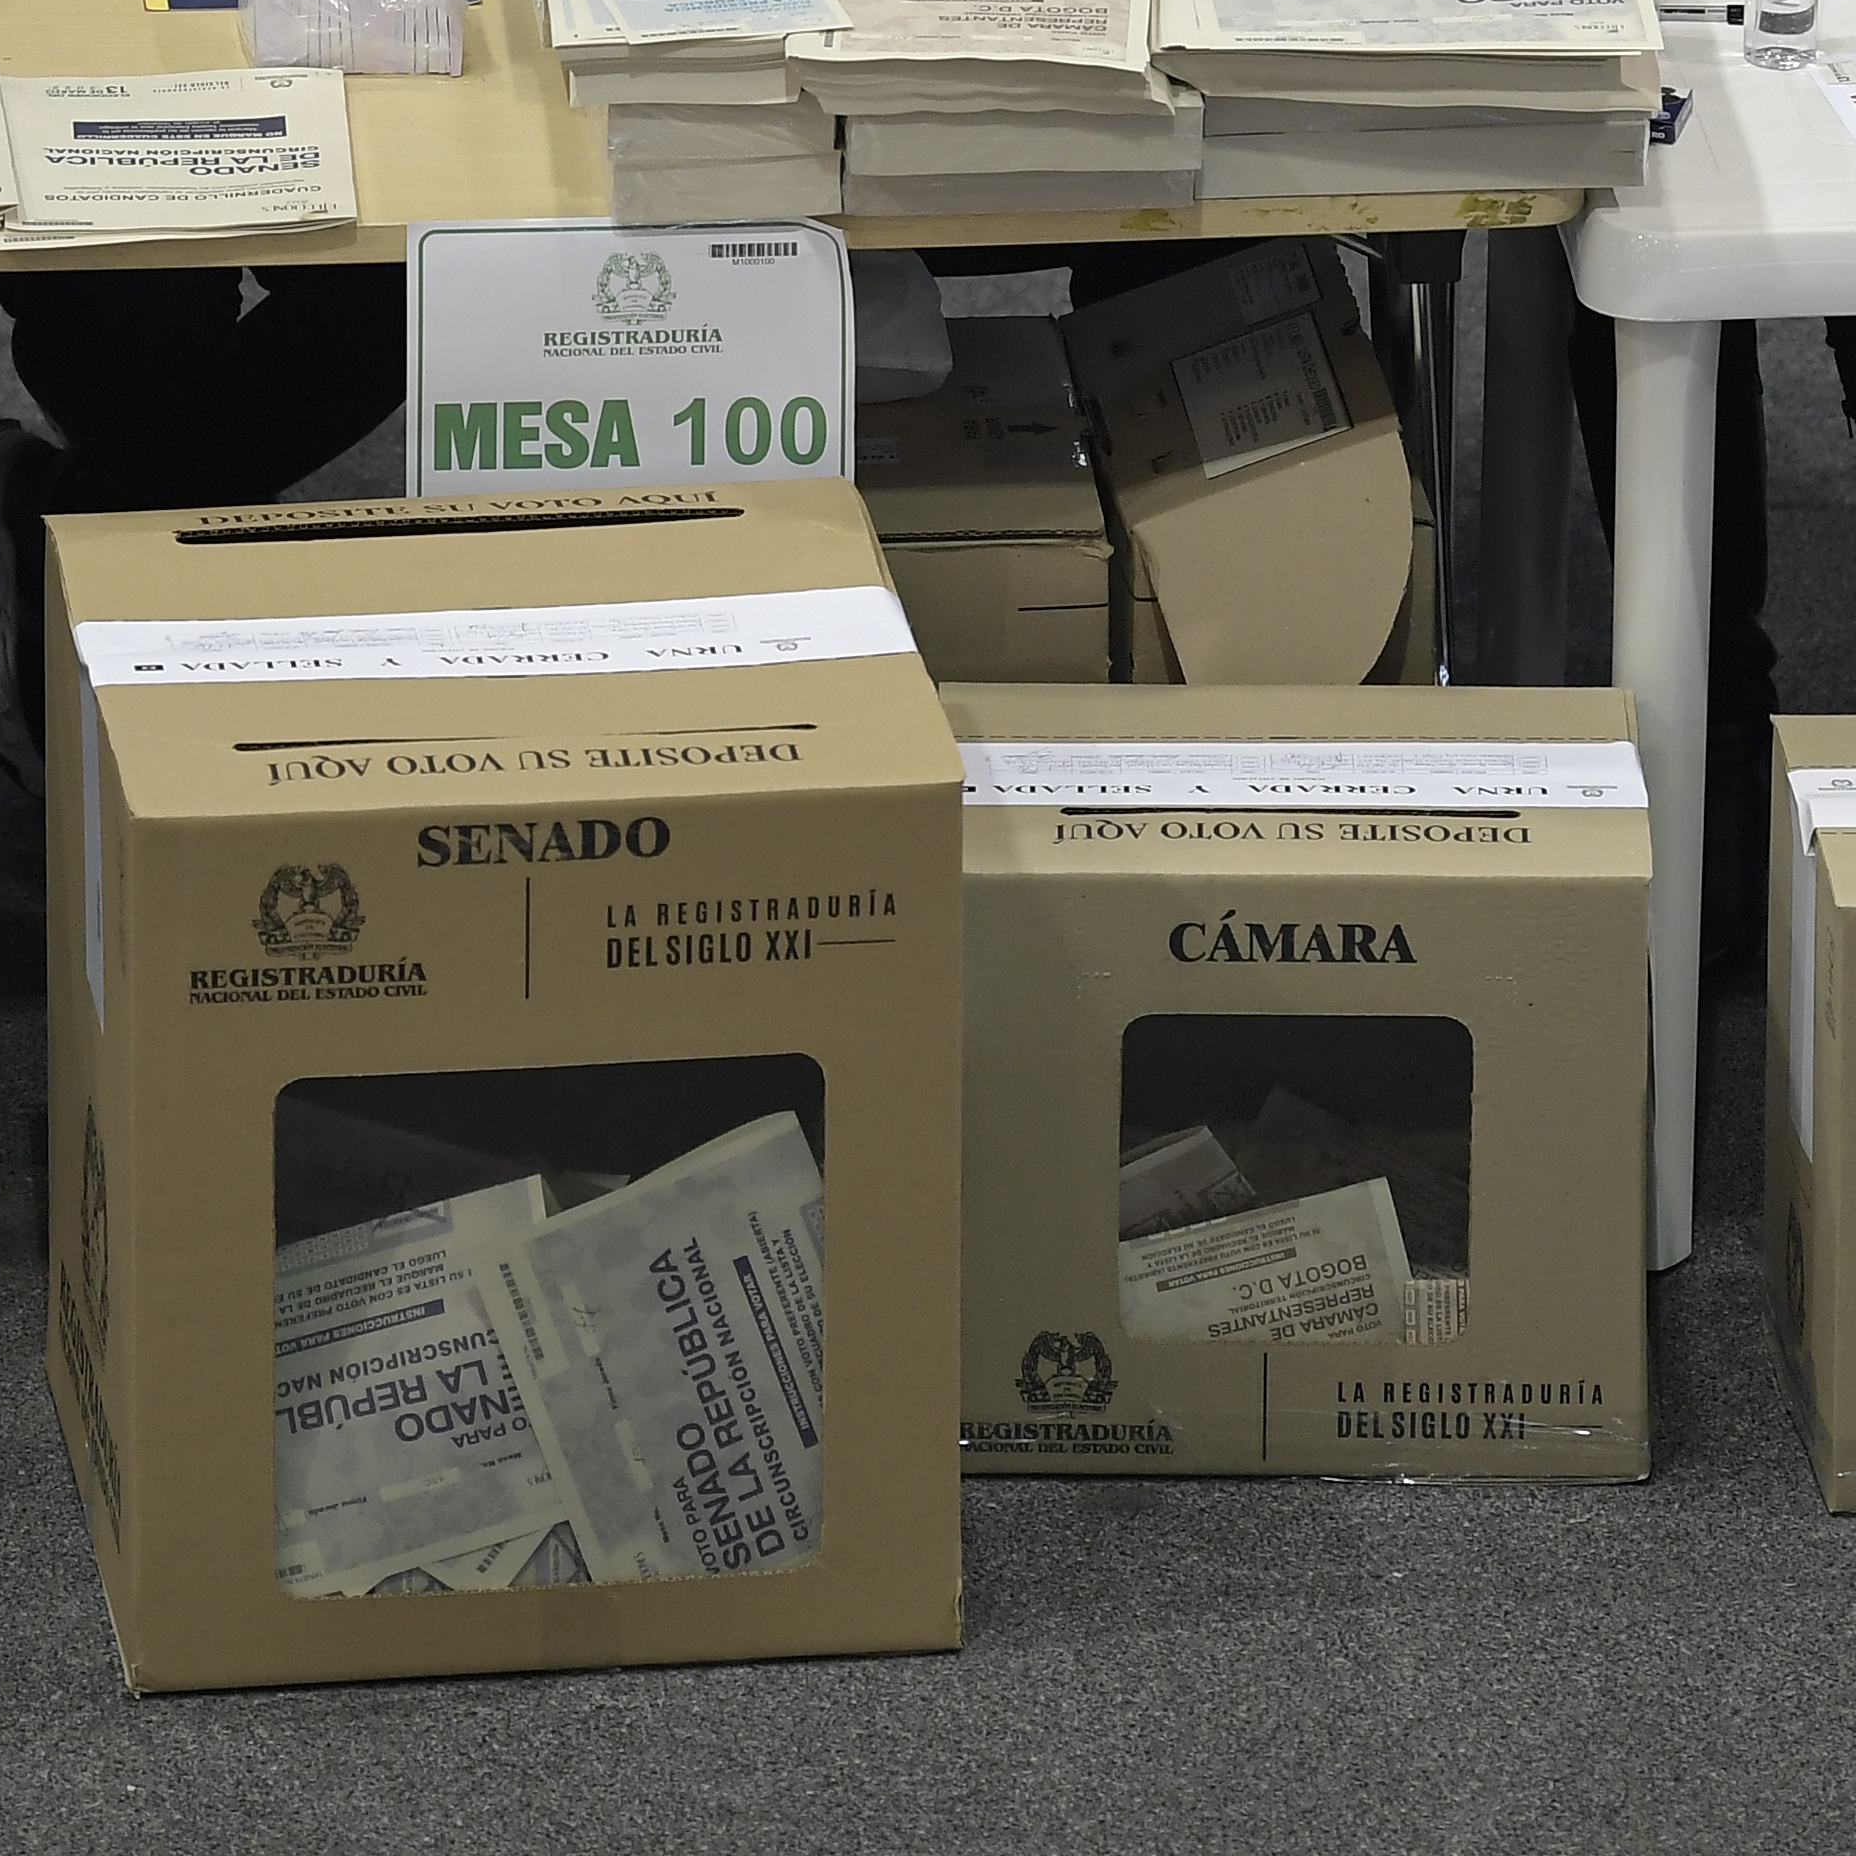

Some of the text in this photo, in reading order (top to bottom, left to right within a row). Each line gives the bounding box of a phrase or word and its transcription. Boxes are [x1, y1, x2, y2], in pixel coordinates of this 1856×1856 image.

[1509, 0, 1562, 8] PARA
[105, 85, 128, 93] 13
[43, 145, 139, 157] NACIONAL
[43, 151, 320, 168] DE LA REPÚBLICA
[188, 159, 320, 175] SENADO
[43, 192, 159, 203] CANDIDATOS
[193, 185, 321, 200] CUADERNILLO
[732, 258, 775, 266] M1000100
[543, 344, 723, 358] NACIONAL DEL ESTADO CIVIL
[544, 324, 723, 346] REGISTRADURÍA
[434, 395, 827, 472] MESA 100
[197, 490, 722, 526] DEPOSITE SU VOTO AQUÍ
[179, 643, 744, 673] URNA CERRADA Y SELLADA
[269, 743, 802, 784] DEPOSITE SU VOTO AQUÍ
[992, 782, 1549, 795] URNA CERRADA Y SELLADA
[416, 815, 671, 869] SENADO
[1053, 820, 1532, 845] DEPOSITE SU VOTO AQUÍ
[607, 889, 898, 928] LA REGISTRADURÍA
[606, 929, 812, 969] DEL SIGLO XXI
[1168, 909, 1417, 965] CÁMARA
[189, 957, 428, 991] REGISTRADURÍA
[189, 982, 428, 1005] NACIONAL DEL ESTADO CIVIL
[303, 1249, 447, 1296] LUEGO EL CANDIDATO DE
[774, 1245, 806, 1312] DE LA LISTA
[780, 1227, 816, 1301] SU ELECCIÓN
[1230, 1253, 1369, 1301] BOGOTA D.C.
[278, 1262, 444, 1315] MARQUE EL RECUADRO DE LA
[334, 1274, 447, 1312] LISTA ES CON VOTO
[298, 1304, 427, 1347] INSTRUCCIONES PARA
[767, 1264, 813, 1367] VOTO PREFERENTE
[1204, 1283, 1376, 1338] REPRESENTANTES
[1269, 1301, 1380, 1340] CÁMARA DE
[1354, 1319, 1382, 1332] VOTO
[327, 1326, 499, 1388] CUNSCRIPCIÓN
[741, 1272, 810, 1432] INSTRUCCIONES PARA VOTAR
[434, 1358, 488, 1396] LA
[680, 1234, 810, 1546] CIRCUNSCRIPCIÓN NACIONAL
[1337, 1378, 1604, 1406] LA REGISTRADURÍA
[274, 1372, 429, 1443] REPÚBL
[642, 1244, 786, 1558] DE LA REPÚBLICA
[449, 1422, 507, 1449] PARA
[960, 1416, 1173, 1443] REGISTRADURÍA
[1337, 1411, 1526, 1440] DEL SIGLO XXI
[1071, 1442, 1126, 1454] ESTADO
[1132, 1443, 1174, 1455] CIVIL
[672, 1417, 754, 1572] SENADO
[670, 1474, 721, 1576] VOTO PARA
